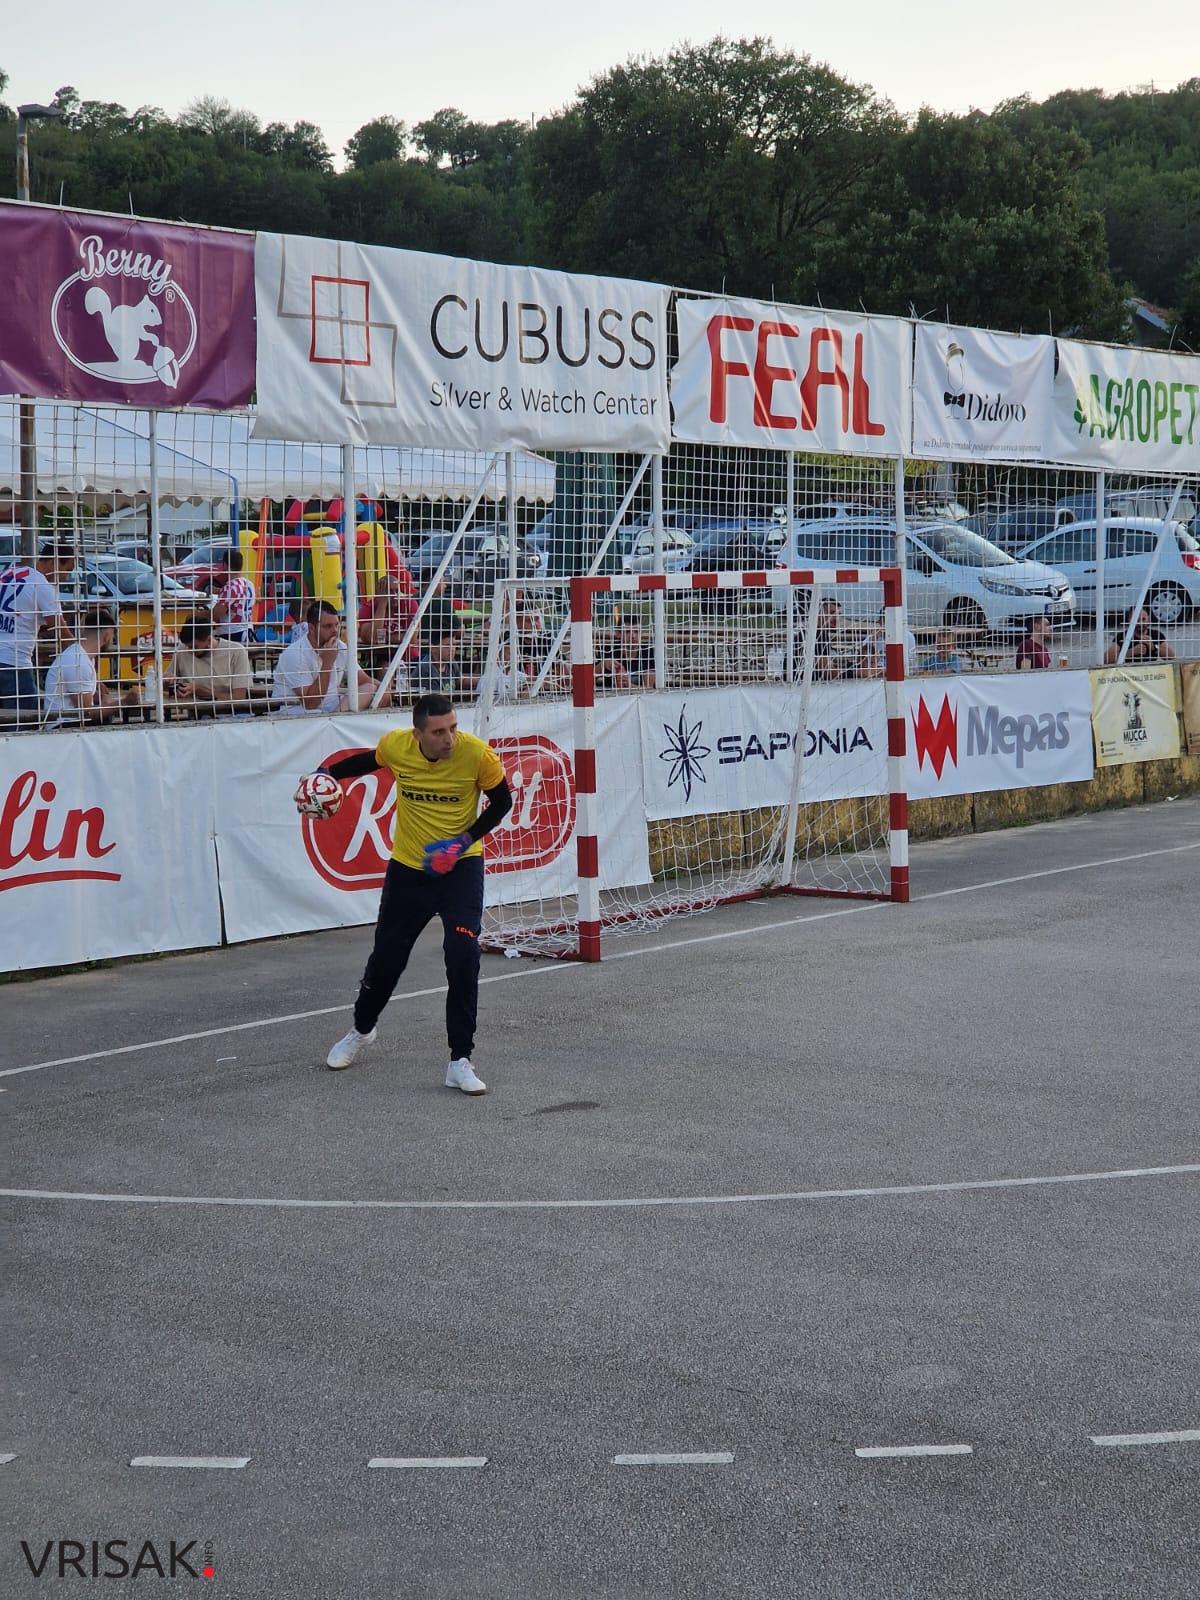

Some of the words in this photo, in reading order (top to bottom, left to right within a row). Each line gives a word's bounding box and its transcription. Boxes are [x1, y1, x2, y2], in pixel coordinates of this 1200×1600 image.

[80, 235, 172, 296] Berny
[430, 294, 656, 371] CUBUSS
[430, 381, 491, 410] Silver
[499, 386, 513, 412] &
[521, 387, 586, 415] Watch
[593, 390, 657, 415] Centar
[707, 314, 886, 436] FEAL
[717, 726, 873, 764] SAPONIA
[966, 705, 1070, 768] Mepas
[1123, 729, 1148, 742] MUCCA
[401, 791, 460, 803] Matteo
